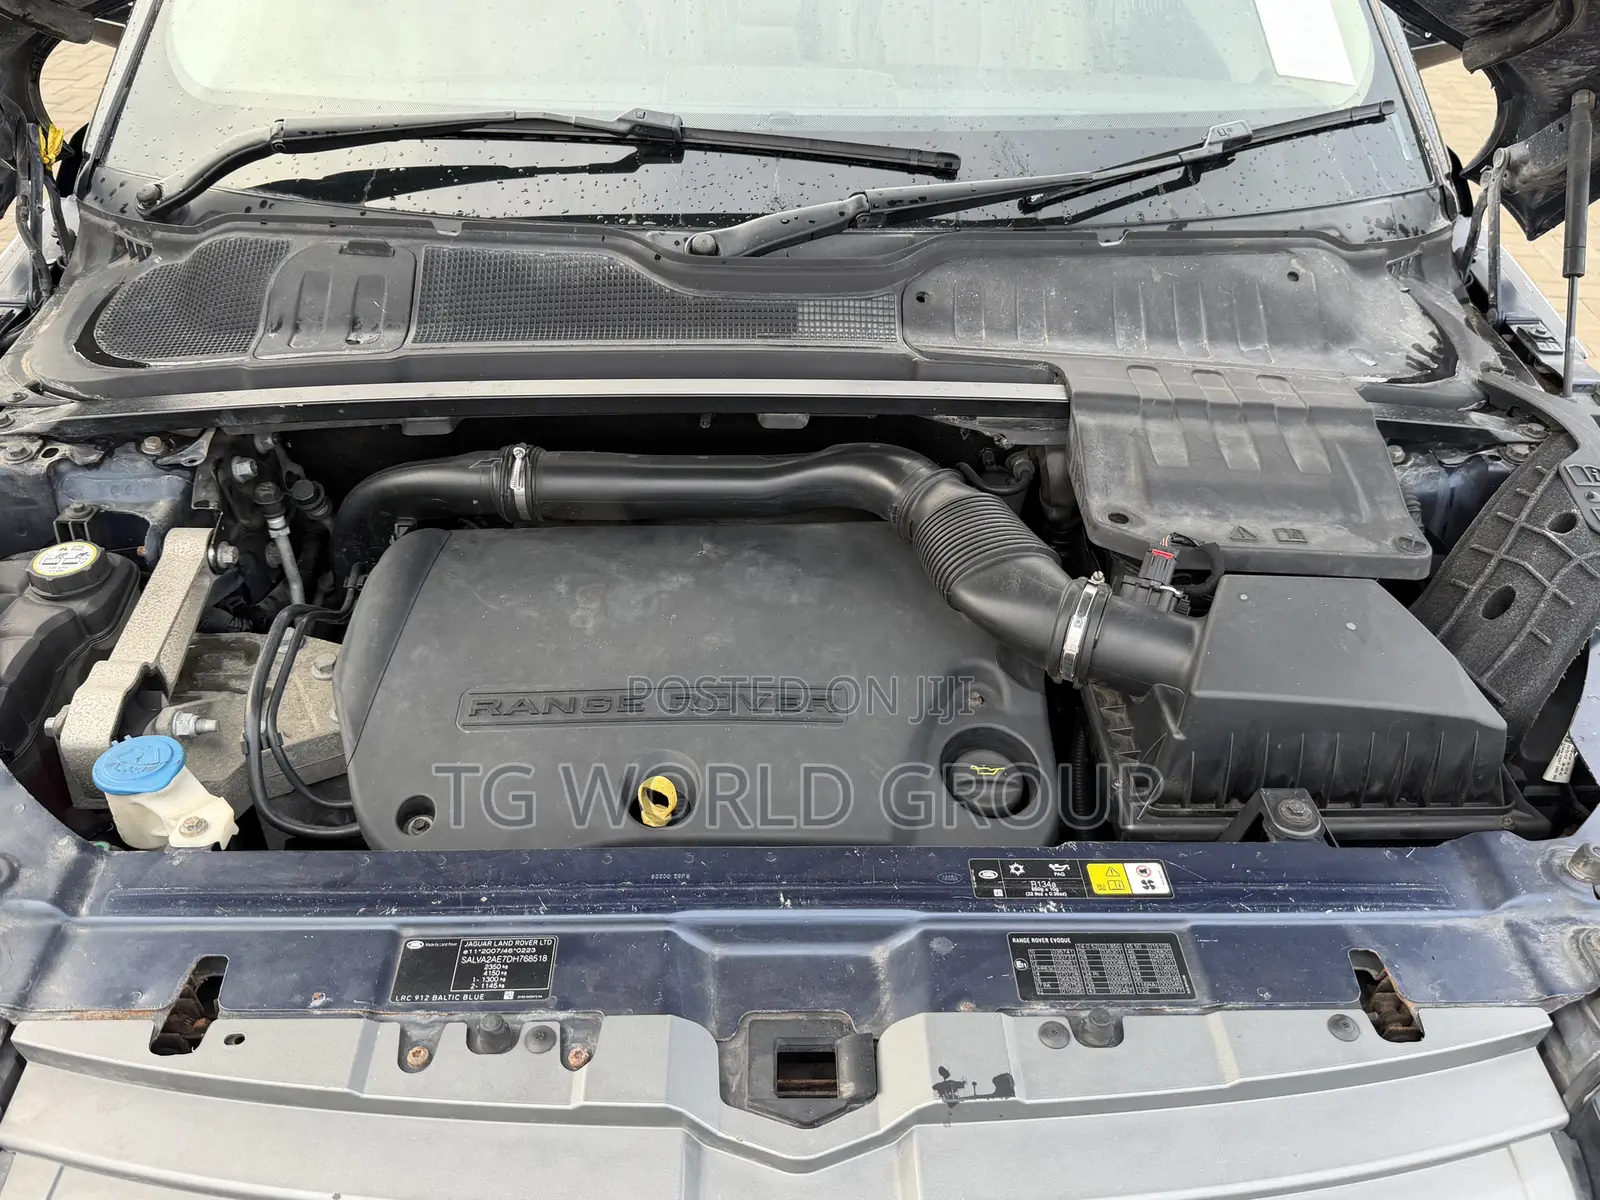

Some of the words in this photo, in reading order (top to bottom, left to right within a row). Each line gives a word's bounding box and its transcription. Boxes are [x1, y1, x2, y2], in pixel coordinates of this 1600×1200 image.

[468, 694, 646, 717] RANGE
[668, 691, 838, 713] ROVER
[515, 939, 539, 947] ROVER
[395, 994, 412, 1002] LRC
[432, 993, 461, 1001] BALTIC
[462, 993, 485, 1001] BLUE
